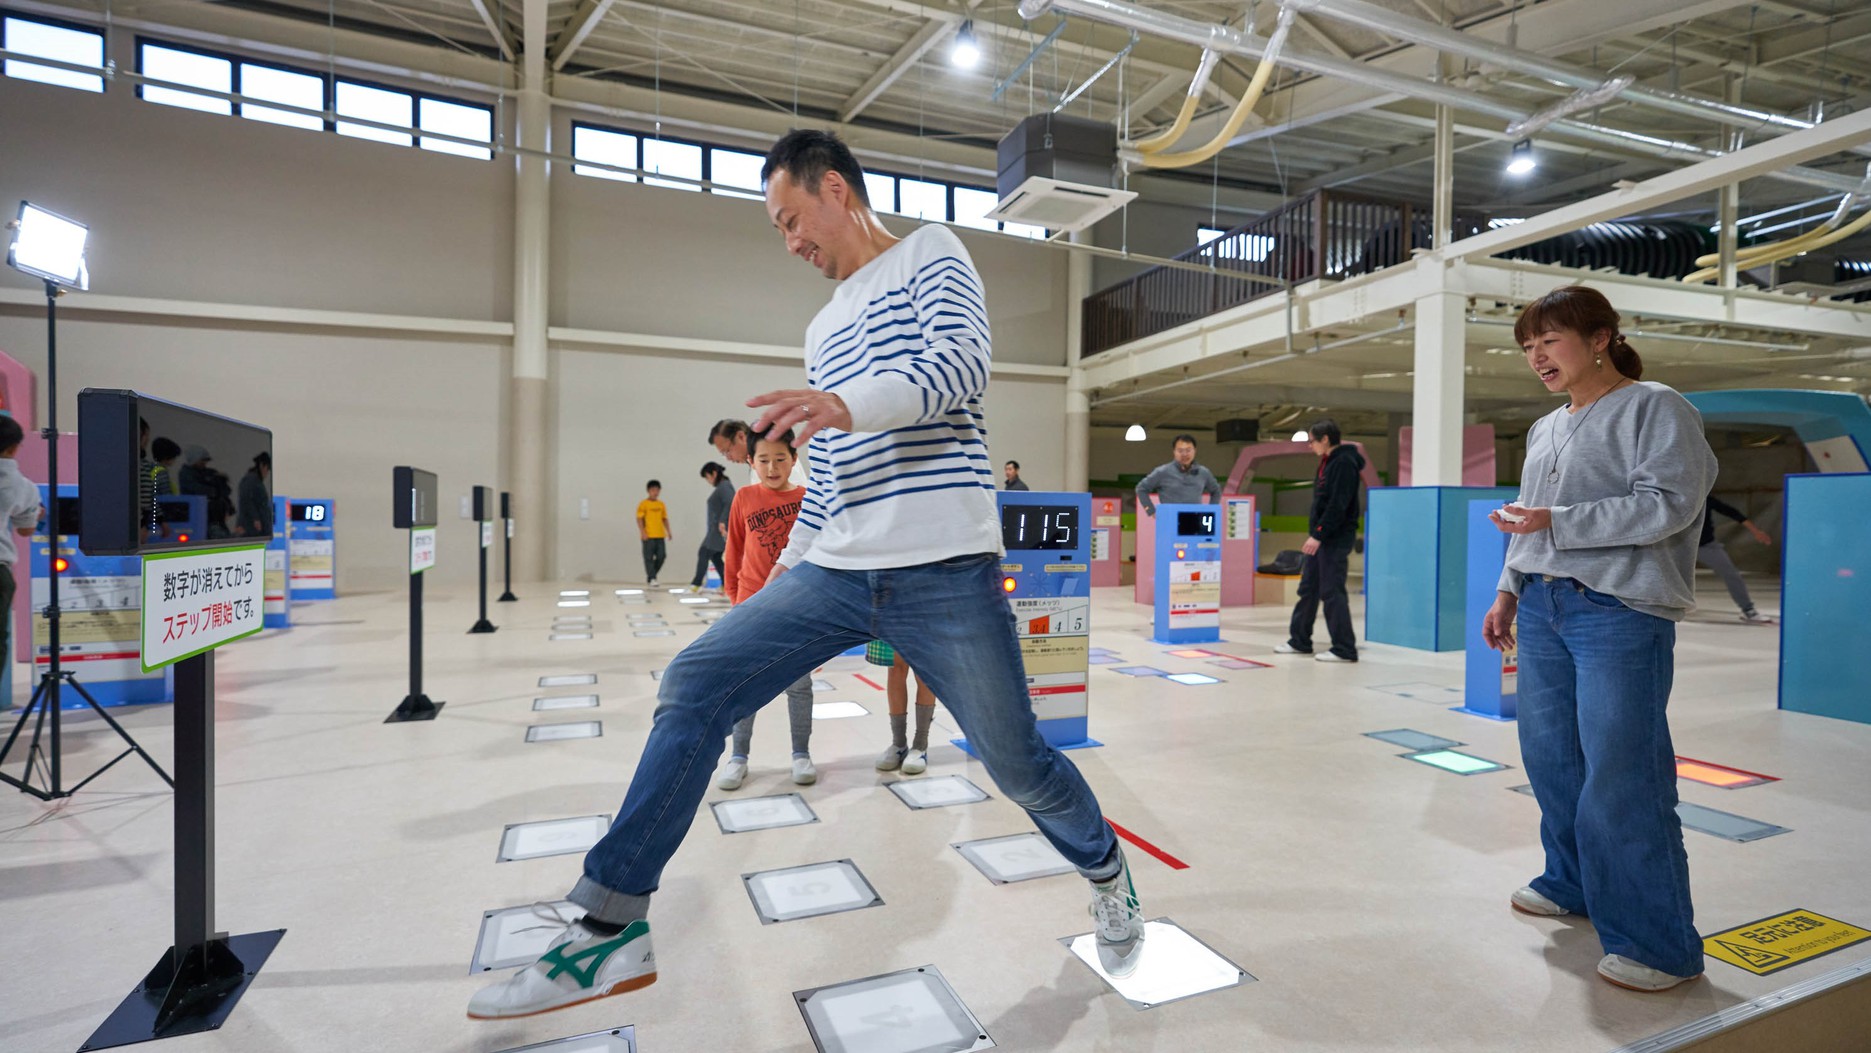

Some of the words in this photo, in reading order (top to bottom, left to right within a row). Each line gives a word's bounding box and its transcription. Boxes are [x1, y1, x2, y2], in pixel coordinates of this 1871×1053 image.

[305, 505, 325, 521] 18
[1202, 515, 1213, 532] 4
[1019, 512, 1071, 543] 115
[163, 562, 253, 602] 数字が消えてから
[162, 596, 254, 644] ステップ開始です。
[1054, 621, 1062, 632] 4
[1074, 617, 1083, 631] 5
[999, 848, 1044, 862] 2
[786, 881, 832, 897] 5
[1739, 915, 1826, 945] 足元に注意
[859, 1004, 914, 1029] 4
